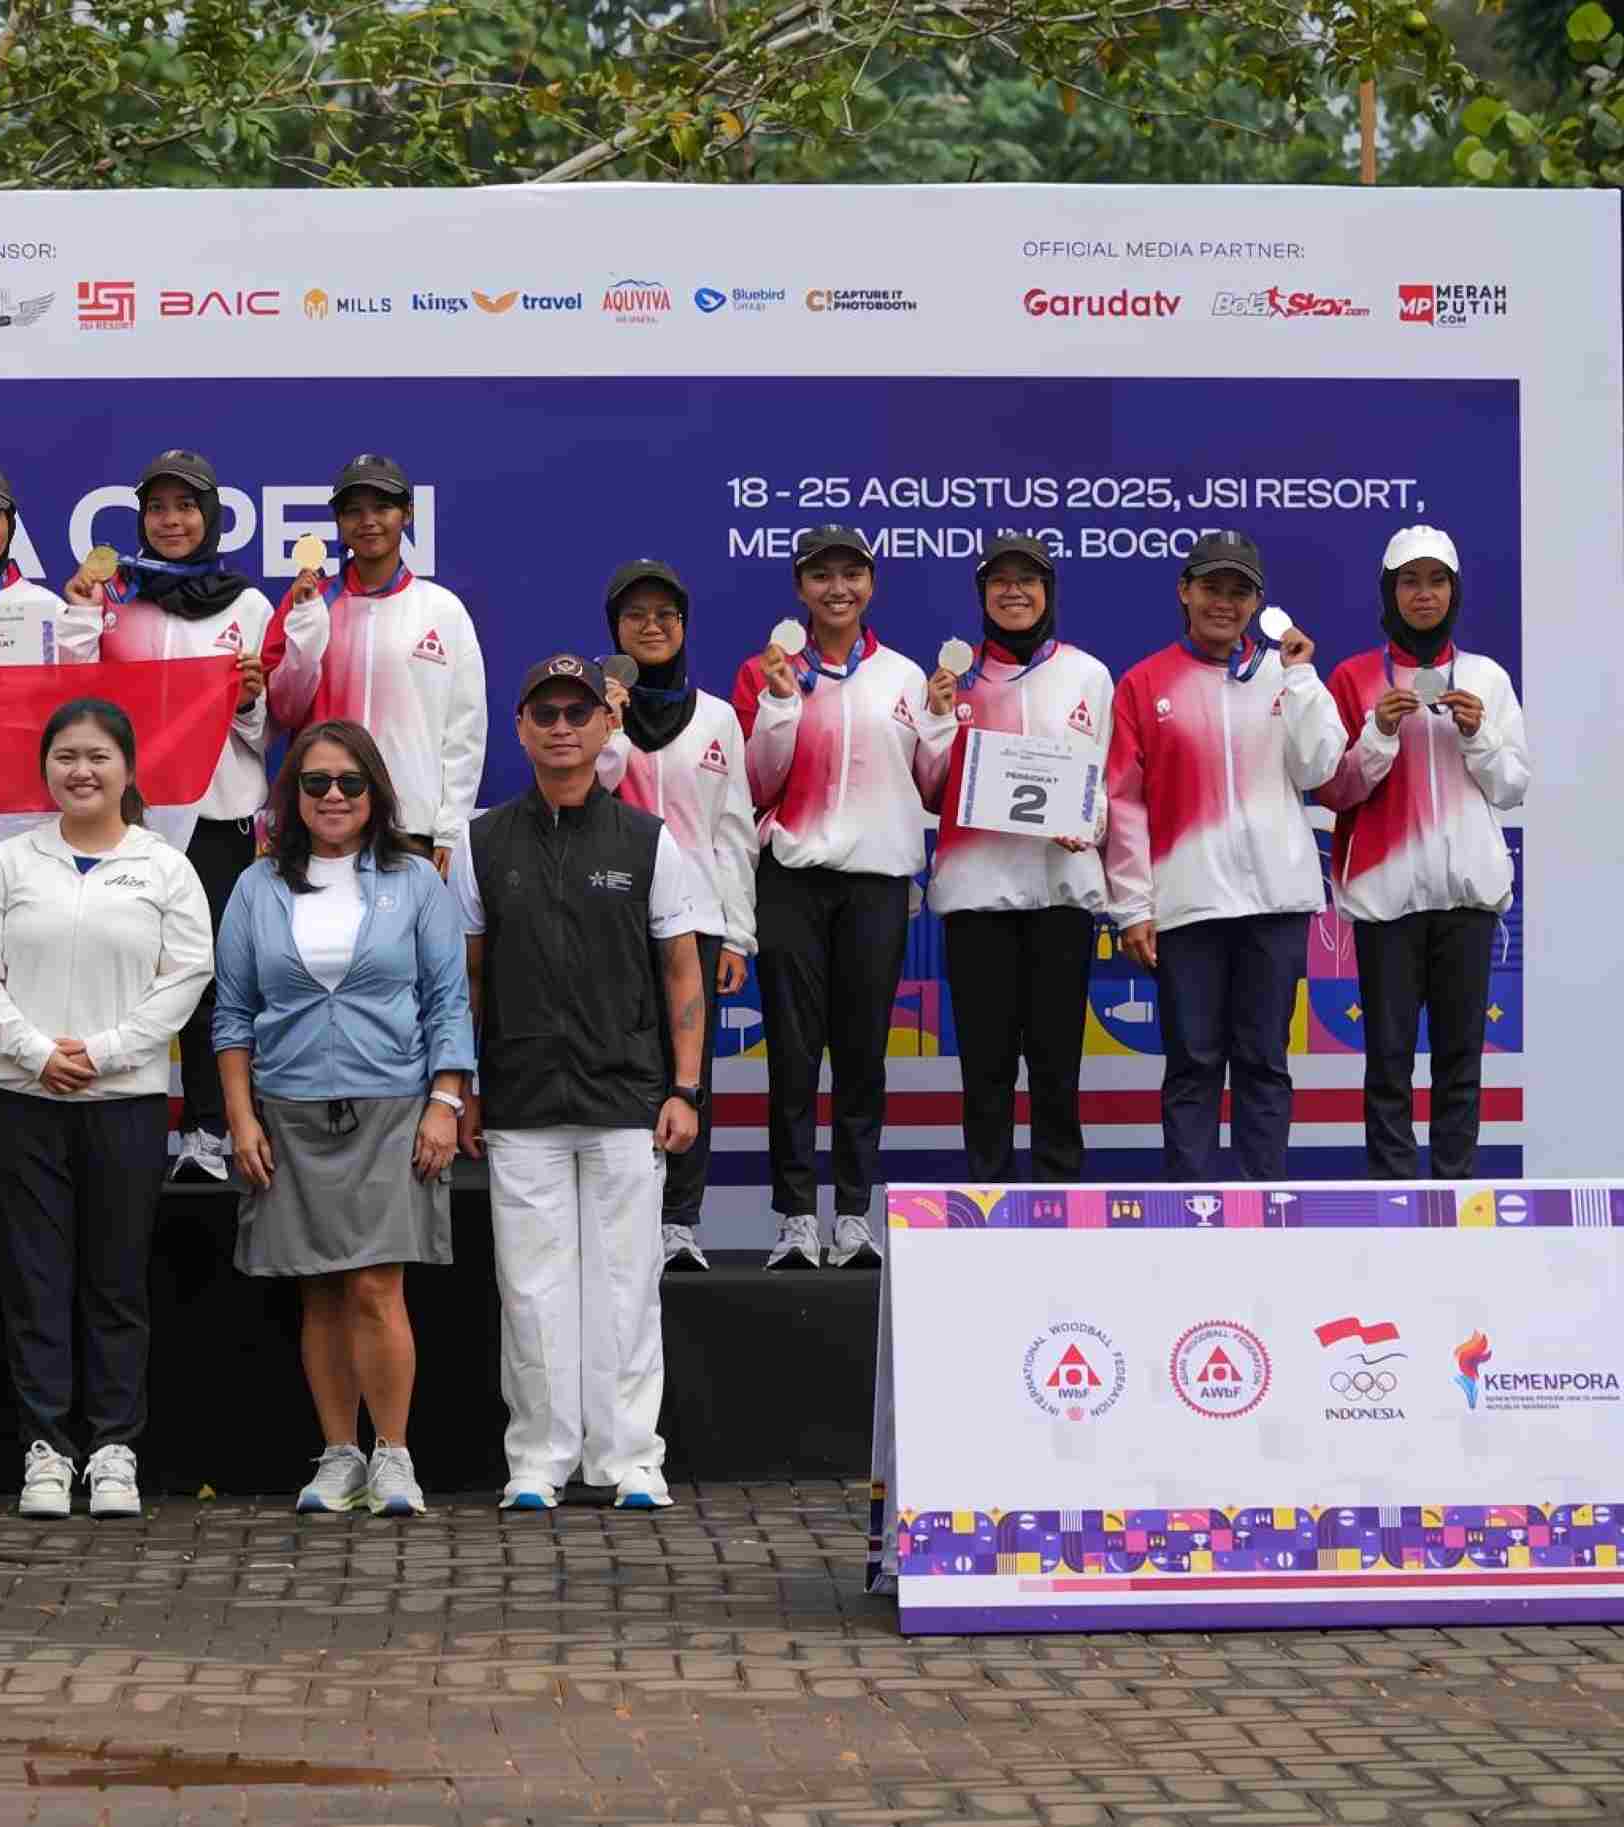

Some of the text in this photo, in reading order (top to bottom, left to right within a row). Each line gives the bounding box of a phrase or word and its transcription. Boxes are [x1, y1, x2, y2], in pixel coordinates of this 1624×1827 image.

[1022, 240, 1306, 259] OFFICIAL MEDIA PARTNER:
[602, 290, 672, 311] AQUVIVA
[731, 288, 786, 301] Bluebird
[833, 289, 904, 300] CAPTURE IT
[1436, 285, 1507, 299] MERAH
[159, 290, 280, 316] BAIC
[336, 297, 392, 313] MILLS
[411, 292, 583, 313] Kings travel
[833, 300, 918, 311] PHOTOBOOTH
[1023, 288, 1181, 317] Garudatv
[1436, 300, 1507, 315] PUTIH
[726, 477, 770, 509] 18
[797, 477, 851, 509] 25
[858, 477, 1060, 509] AGUSTUS
[1065, 477, 1182, 514] 2025,
[1187, 477, 1248, 509] JSI
[1254, 477, 1426, 514] RESORT,
[1080, 527, 1223, 559] BOGO
[1008, 784, 1048, 824] 2
[1484, 1372, 1621, 1391] KEMENPORA
[1324, 1407, 1407, 1421] INDONESIA
